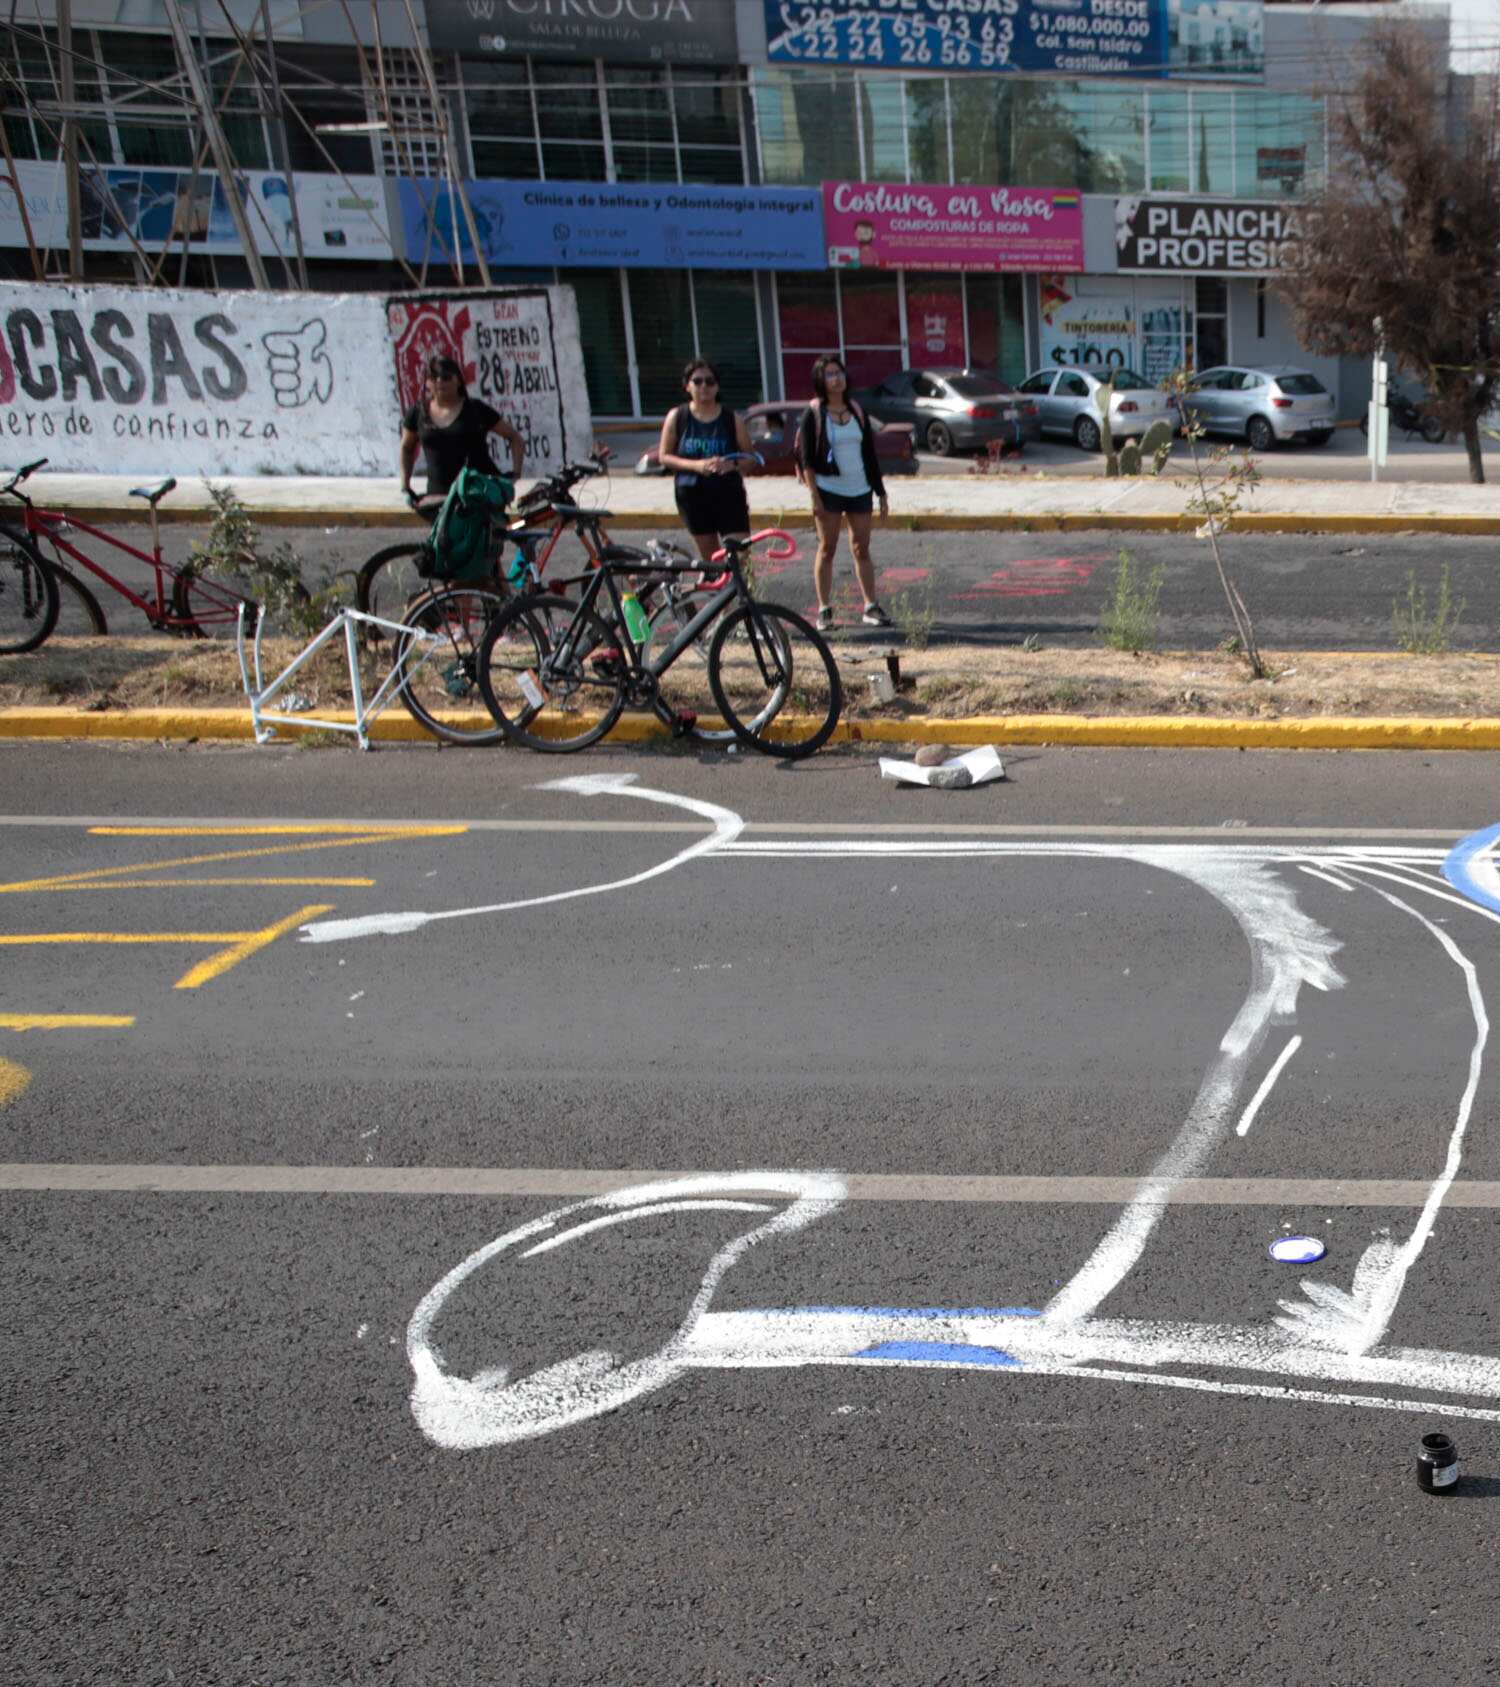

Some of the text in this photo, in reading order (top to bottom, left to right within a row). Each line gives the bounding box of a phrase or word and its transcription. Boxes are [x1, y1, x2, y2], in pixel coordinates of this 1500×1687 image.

[801, 7, 1014, 43] 22 22 65 93 63
[1091, 0, 1148, 18] DESDE
[804, 33, 1011, 65] 22 24 26 56 59
[1036, 33, 1143, 54] Col. San Isidro
[578, 192, 595, 208] de
[833, 183, 1054, 221] Costura en Rosa
[890, 218, 1030, 234] COMPOSTURAS DE ROPA
[1147, 207, 1306, 239] PLANCHA
[1137, 237, 1302, 269] PROFESIO
[0, 308, 248, 405] CASAS
[480, 351, 506, 396] 28
[513, 362, 556, 396] ABRIL
[0, 405, 280, 440] ero de confianza
[503, 430, 551, 460] Pdro
